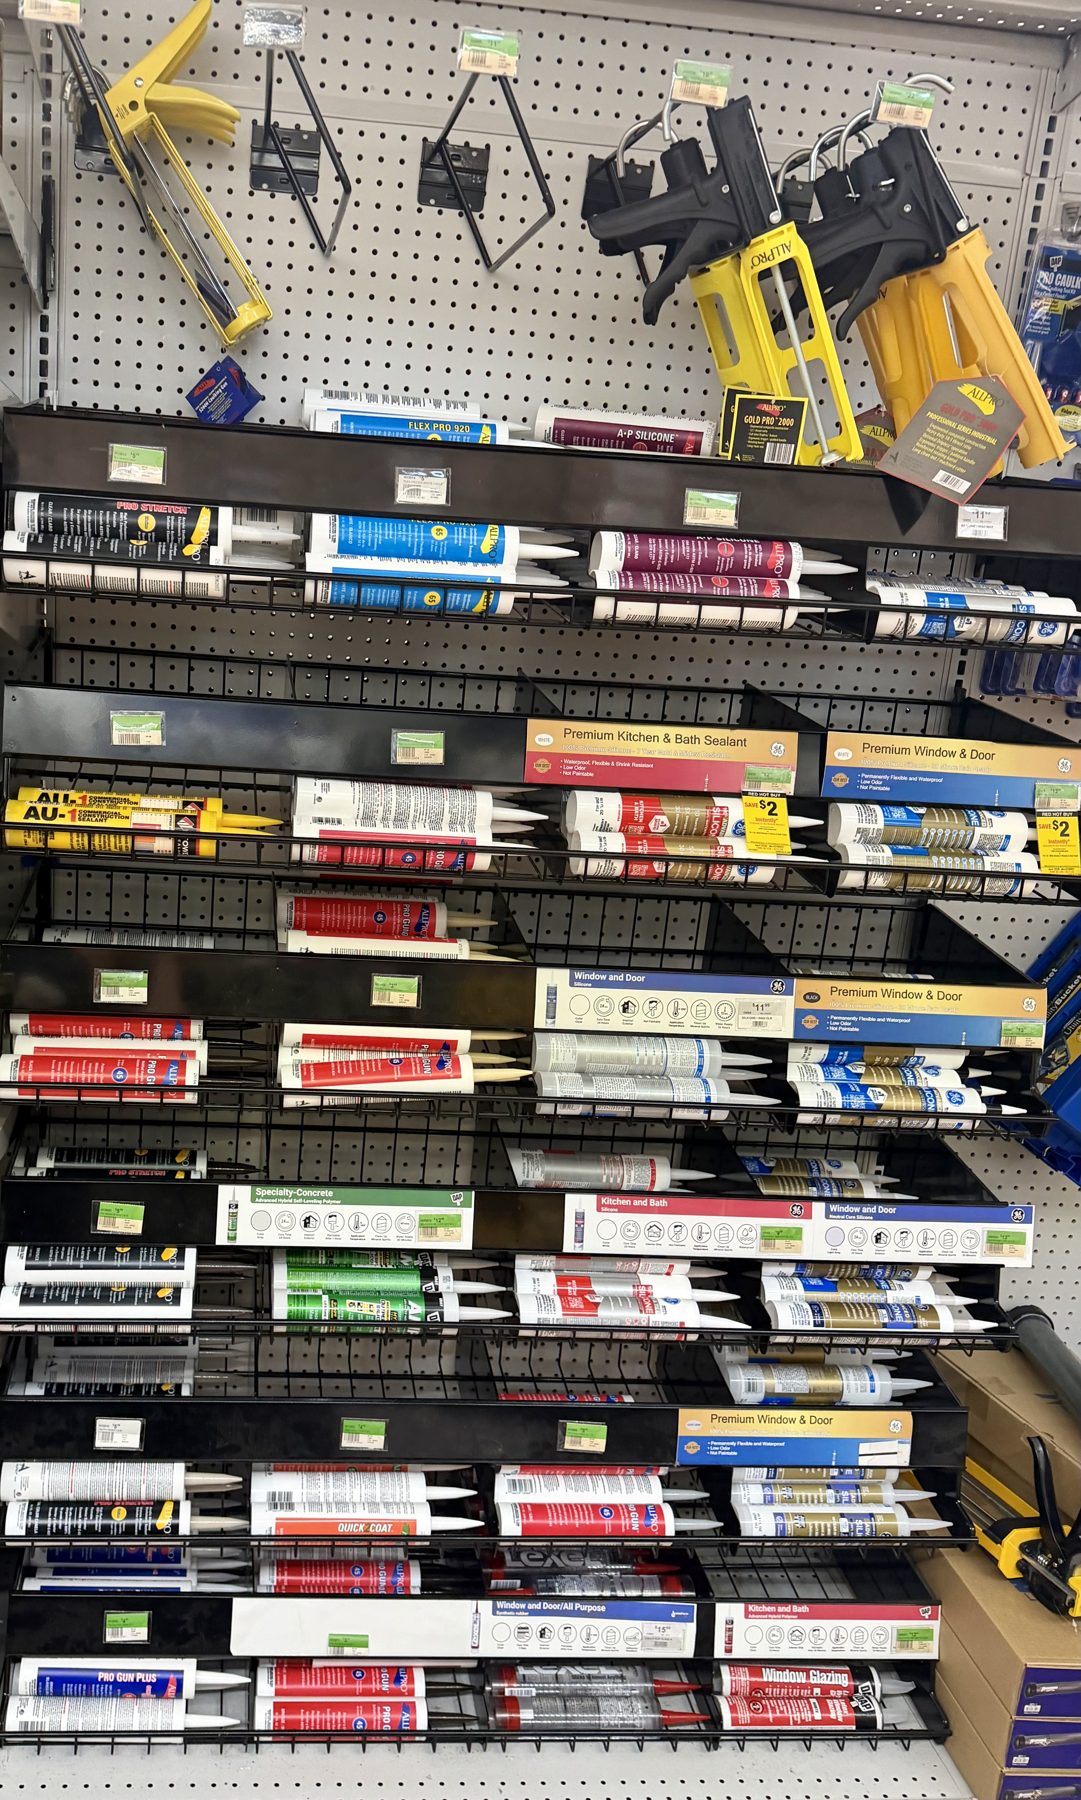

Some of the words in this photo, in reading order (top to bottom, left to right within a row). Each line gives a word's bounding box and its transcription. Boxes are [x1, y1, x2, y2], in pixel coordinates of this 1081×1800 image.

[751, 240, 793, 270] ALLPRO
[1051, 257, 1062, 265] DAP
[1038, 271, 1054, 286] PRO
[968, 387, 1005, 408] ALLPRO
[744, 415, 760, 424] GOLD
[761, 417, 775, 425] PRO
[778, 418, 795, 426] 2000
[409, 421, 430, 431] FLEX
[432, 423, 451, 432] PRO
[453, 424, 470, 433] 920
[635, 431, 676, 443] SILICONE
[116, 501, 139, 511] PRO
[140, 502, 188, 514] STRETCH
[435, 528, 444, 537] 65
[489, 524, 498, 559] ALLPRO
[774, 543, 782, 576] ALLPRO
[428, 593, 438, 604] 65
[563, 728, 614, 741] Premium
[618, 731, 660, 743] Kitchen
[662, 733, 671, 744] &
[674, 734, 701, 745] Bath
[704, 735, 747, 747] Sealant
[862, 743, 911, 755] Premium
[914, 745, 957, 758] Window
[959, 747, 967, 759] &
[970, 749, 996, 761] Door
[861, 773, 890, 781] Permanently
[23, 805, 77, 822] AU-1
[759, 799, 779, 816] $2
[1052, 819, 1070, 837] $2
[402, 904, 410, 916] PRO
[574, 972, 607, 980] Window
[609, 973, 624, 981] and
[626, 974, 645, 982] Door
[830, 986, 878, 998] Premium
[881, 988, 924, 1001] Window
[926, 990, 934, 1001] &
[937, 991, 962, 1002] Door
[148, 1060, 156, 1071] PRO
[115, 1070, 125, 1080] 45
[255, 1188, 334, 1198] Specialty-Concrete
[452, 1194, 463, 1202] DAP
[601, 1197, 630, 1206] Kitchen
[649, 1199, 668, 1207] Bath
[829, 1205, 860, 1213] Window
[862, 1206, 876, 1214] and
[878, 1206, 896, 1214] Door
[711, 1414, 754, 1426] Premium
[757, 1415, 797, 1425] Window
[799, 1415, 806, 1425] &
[810, 1416, 833, 1425] Door
[632, 1513, 640, 1531] GUN
[353, 1566, 361, 1576] 45
[497, 1601, 525, 1610] Window
[543, 1603, 574, 1611] Door/All
[575, 1604, 606, 1612] Purpose
[98, 1672, 115, 1682] PRO
[117, 1673, 135, 1682] GUN
[136, 1673, 157, 1683] PLUS
[762, 1668, 806, 1684] Window
[809, 1669, 849, 1687] Glazing
[858, 1695, 873, 1710] DAP
[356, 1720, 364, 1730] 45
